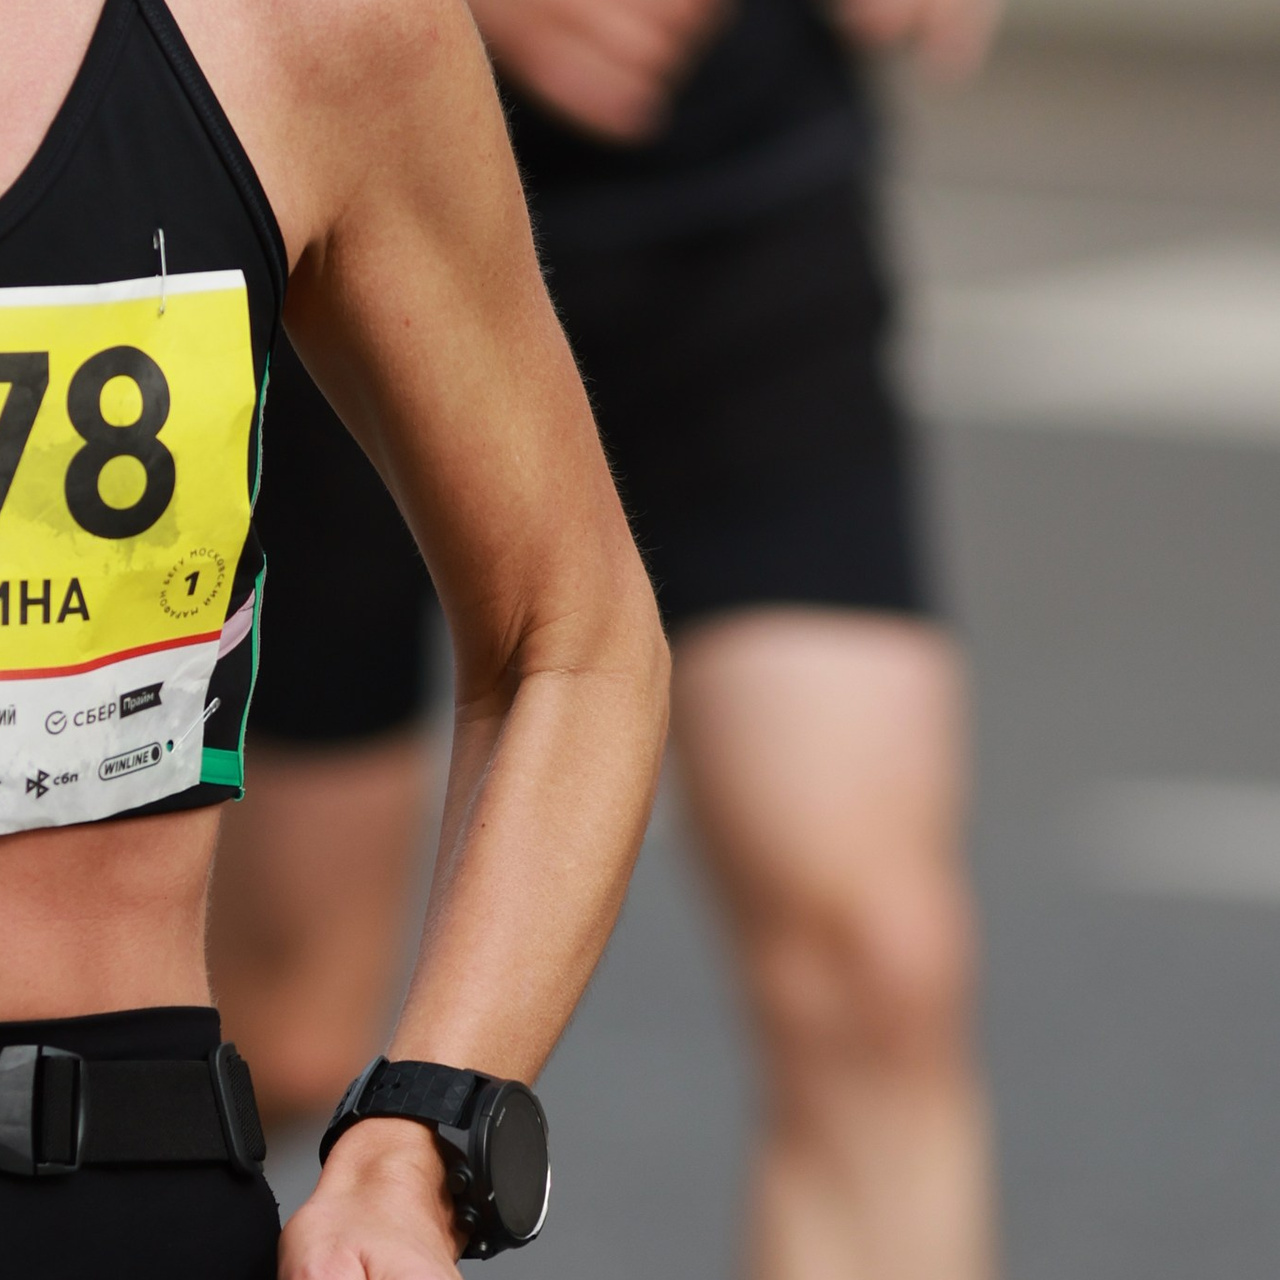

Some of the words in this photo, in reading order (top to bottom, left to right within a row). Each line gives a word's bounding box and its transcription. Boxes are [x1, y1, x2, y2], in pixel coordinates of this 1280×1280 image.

[185, 571, 200, 596] 1
[190, 548, 226, 607] МОСКОВСКИЙ
[160, 590, 199, 619] МАРАФОН
[73, 703, 117, 726] СБЕР
[123, 691, 155, 711] Прайм
[104, 750, 150, 776] WINLINE
[53, 773, 79, 785] сбп
